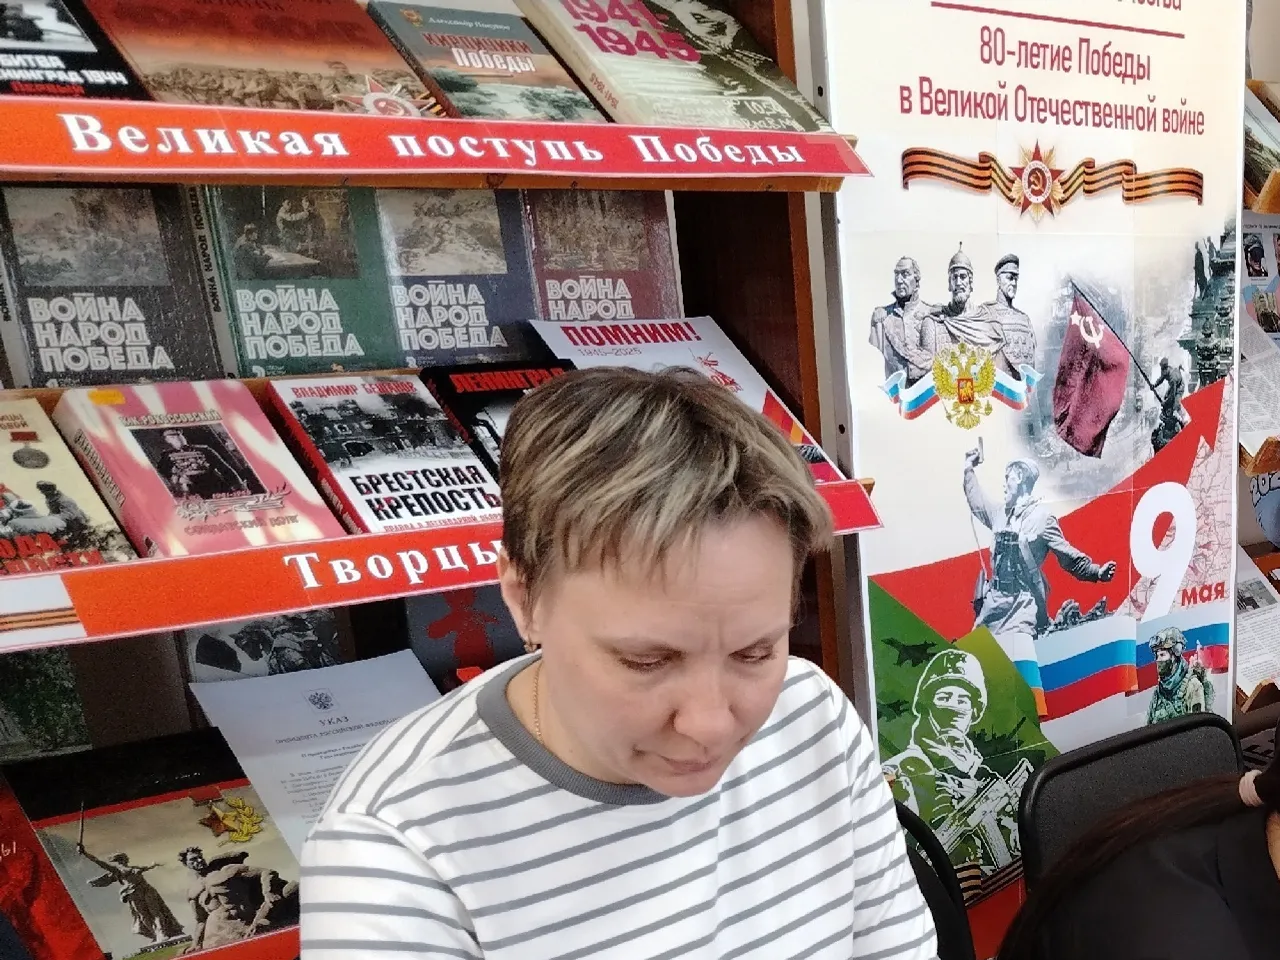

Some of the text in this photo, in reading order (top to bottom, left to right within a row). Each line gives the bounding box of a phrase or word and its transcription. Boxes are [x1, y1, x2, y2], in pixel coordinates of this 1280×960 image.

[574, 23, 702, 63] 1945
[980, 26, 1151, 85] 80-летие Победы
[452, 47, 536, 74] Победы
[80, 70, 128, 85] 1944
[900, 75, 1205, 136] в Великой Отечественной войне
[57, 113, 806, 168] Великая поступь Победы
[236, 284, 339, 312] ВОЙНА
[392, 280, 486, 306] ВОЙНА
[545, 275, 633, 301] ВОЙНА
[27, 292, 146, 322] ВОЙНА
[395, 305, 490, 329] НАРОД
[549, 299, 636, 321] НАРОД
[33, 322, 151, 347] НАРОД
[240, 311, 343, 336] НАРОД
[561, 322, 703, 347] ПОМНИМ!
[244, 334, 365, 360] ПОБЕДА
[400, 326, 508, 351] ПОБЕДА
[39, 346, 175, 372] ПОБЕДА
[292, 383, 359, 398] ВЛАДИМИР
[349, 465, 487, 496] БРЕСТСКАЯ
[365, 487, 501, 521] КРЕПОСТЬ
[1130, 481, 1197, 622] 9
[284, 540, 502, 590] Творцы
[319, 716, 349, 726] УКАЗ
